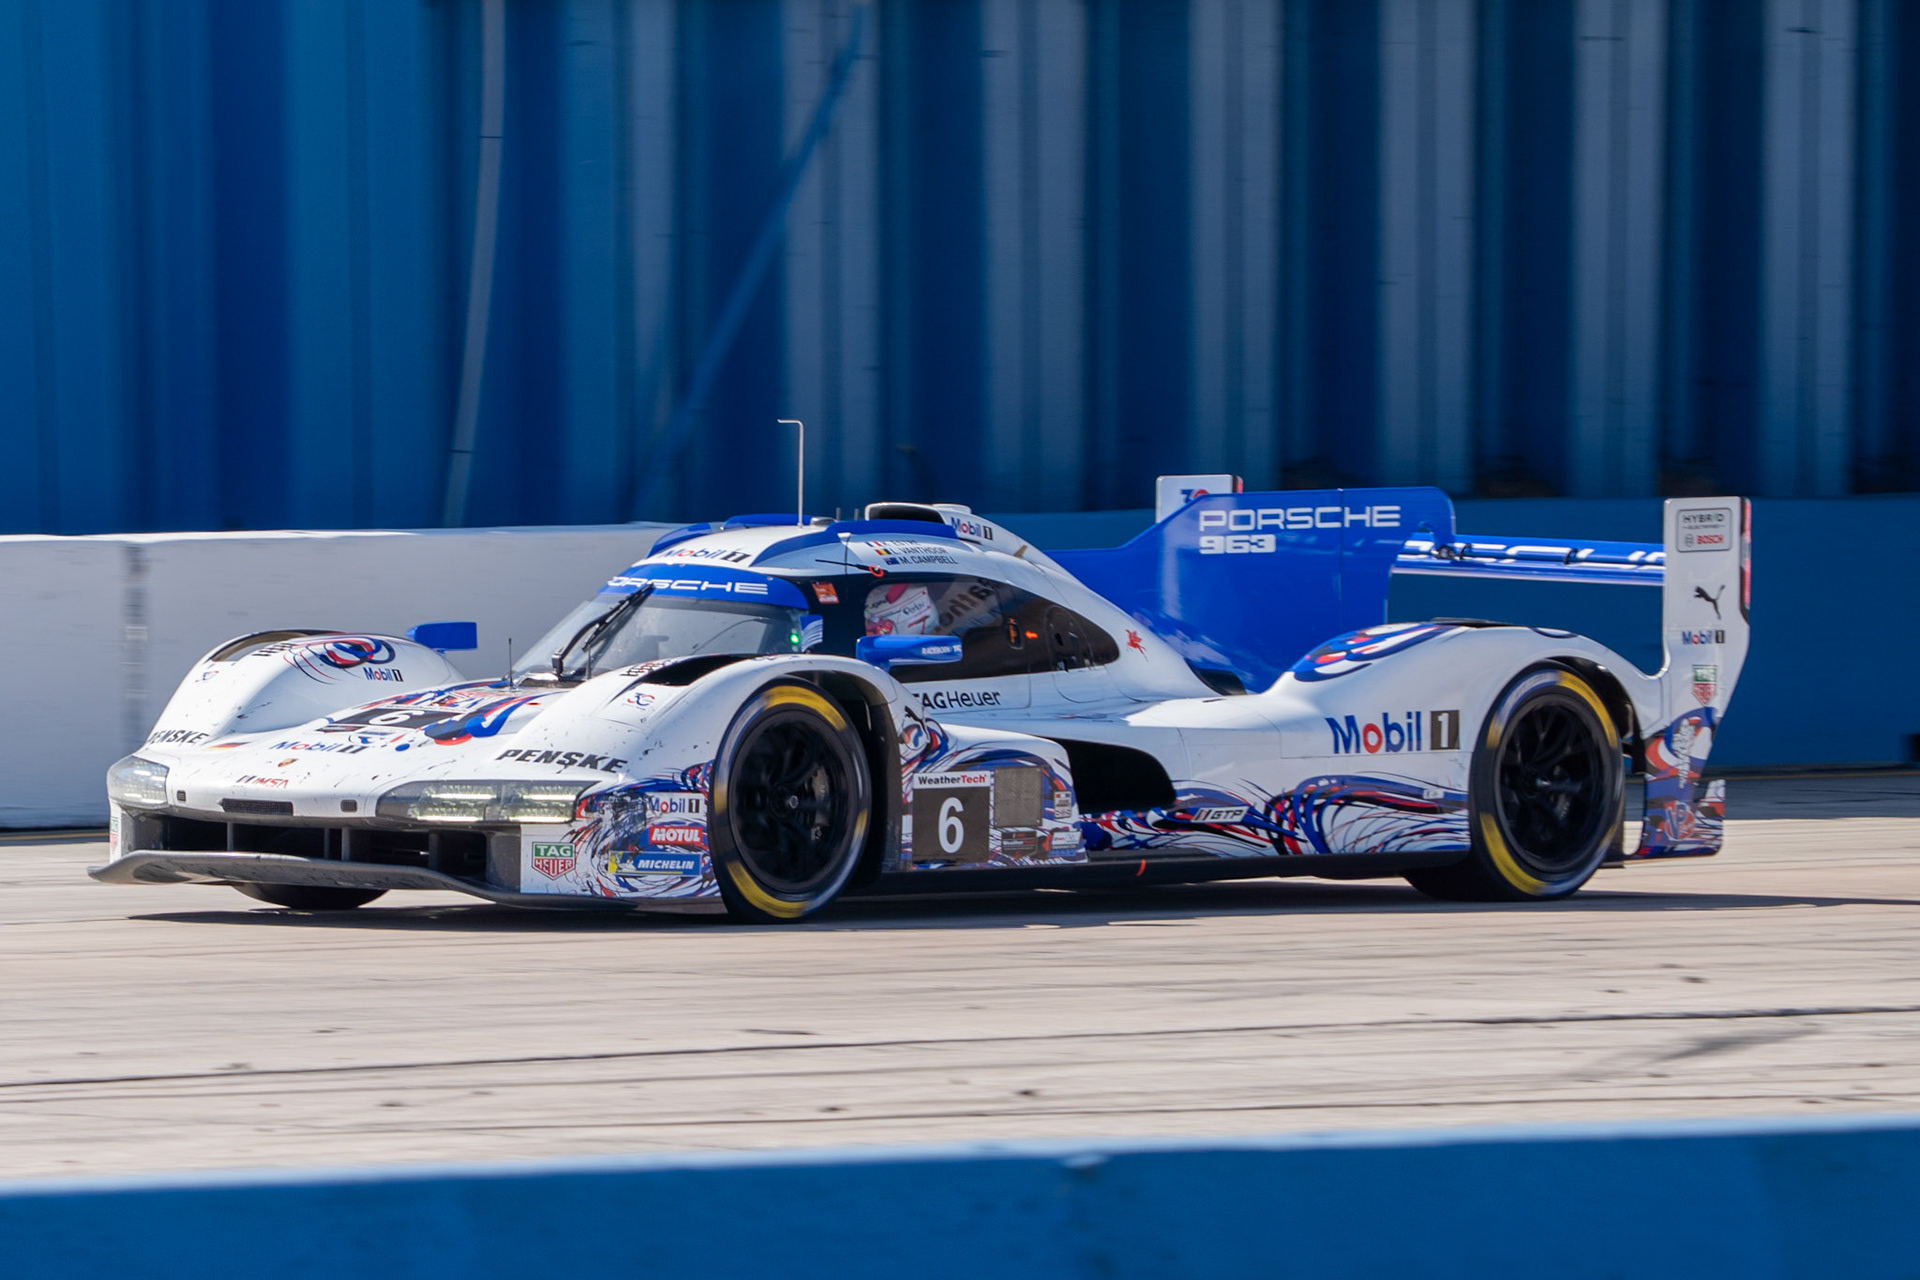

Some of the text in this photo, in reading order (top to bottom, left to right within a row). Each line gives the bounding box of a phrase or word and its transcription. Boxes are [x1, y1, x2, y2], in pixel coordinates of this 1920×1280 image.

[1199, 505, 1401, 532] PORSCHE
[950, 517, 982, 538] Mobil
[899, 546, 949, 556] VANTHOOR
[1199, 534, 1276, 555] 963
[661, 549, 723, 559] Mobil
[899, 555, 959, 565] M. CAMPBELL
[607, 576, 769, 595] ORSCHE
[1682, 630, 1713, 645] Mobil
[363, 667, 394, 681] Mobil
[1325, 711, 1422, 755] Mobil
[269, 741, 343, 752] Mobil
[495, 749, 628, 774] PENSKE
[918, 774, 986, 786] WeatherTech
[649, 797, 686, 814] Mobil
[1209, 808, 1244, 821] GTP
[937, 796, 965, 854] 6
[651, 827, 701, 843] MOTUL
[536, 844, 572, 857] TAG
[535, 859, 574, 878] HEUER
[637, 858, 695, 870] MICHELIN
